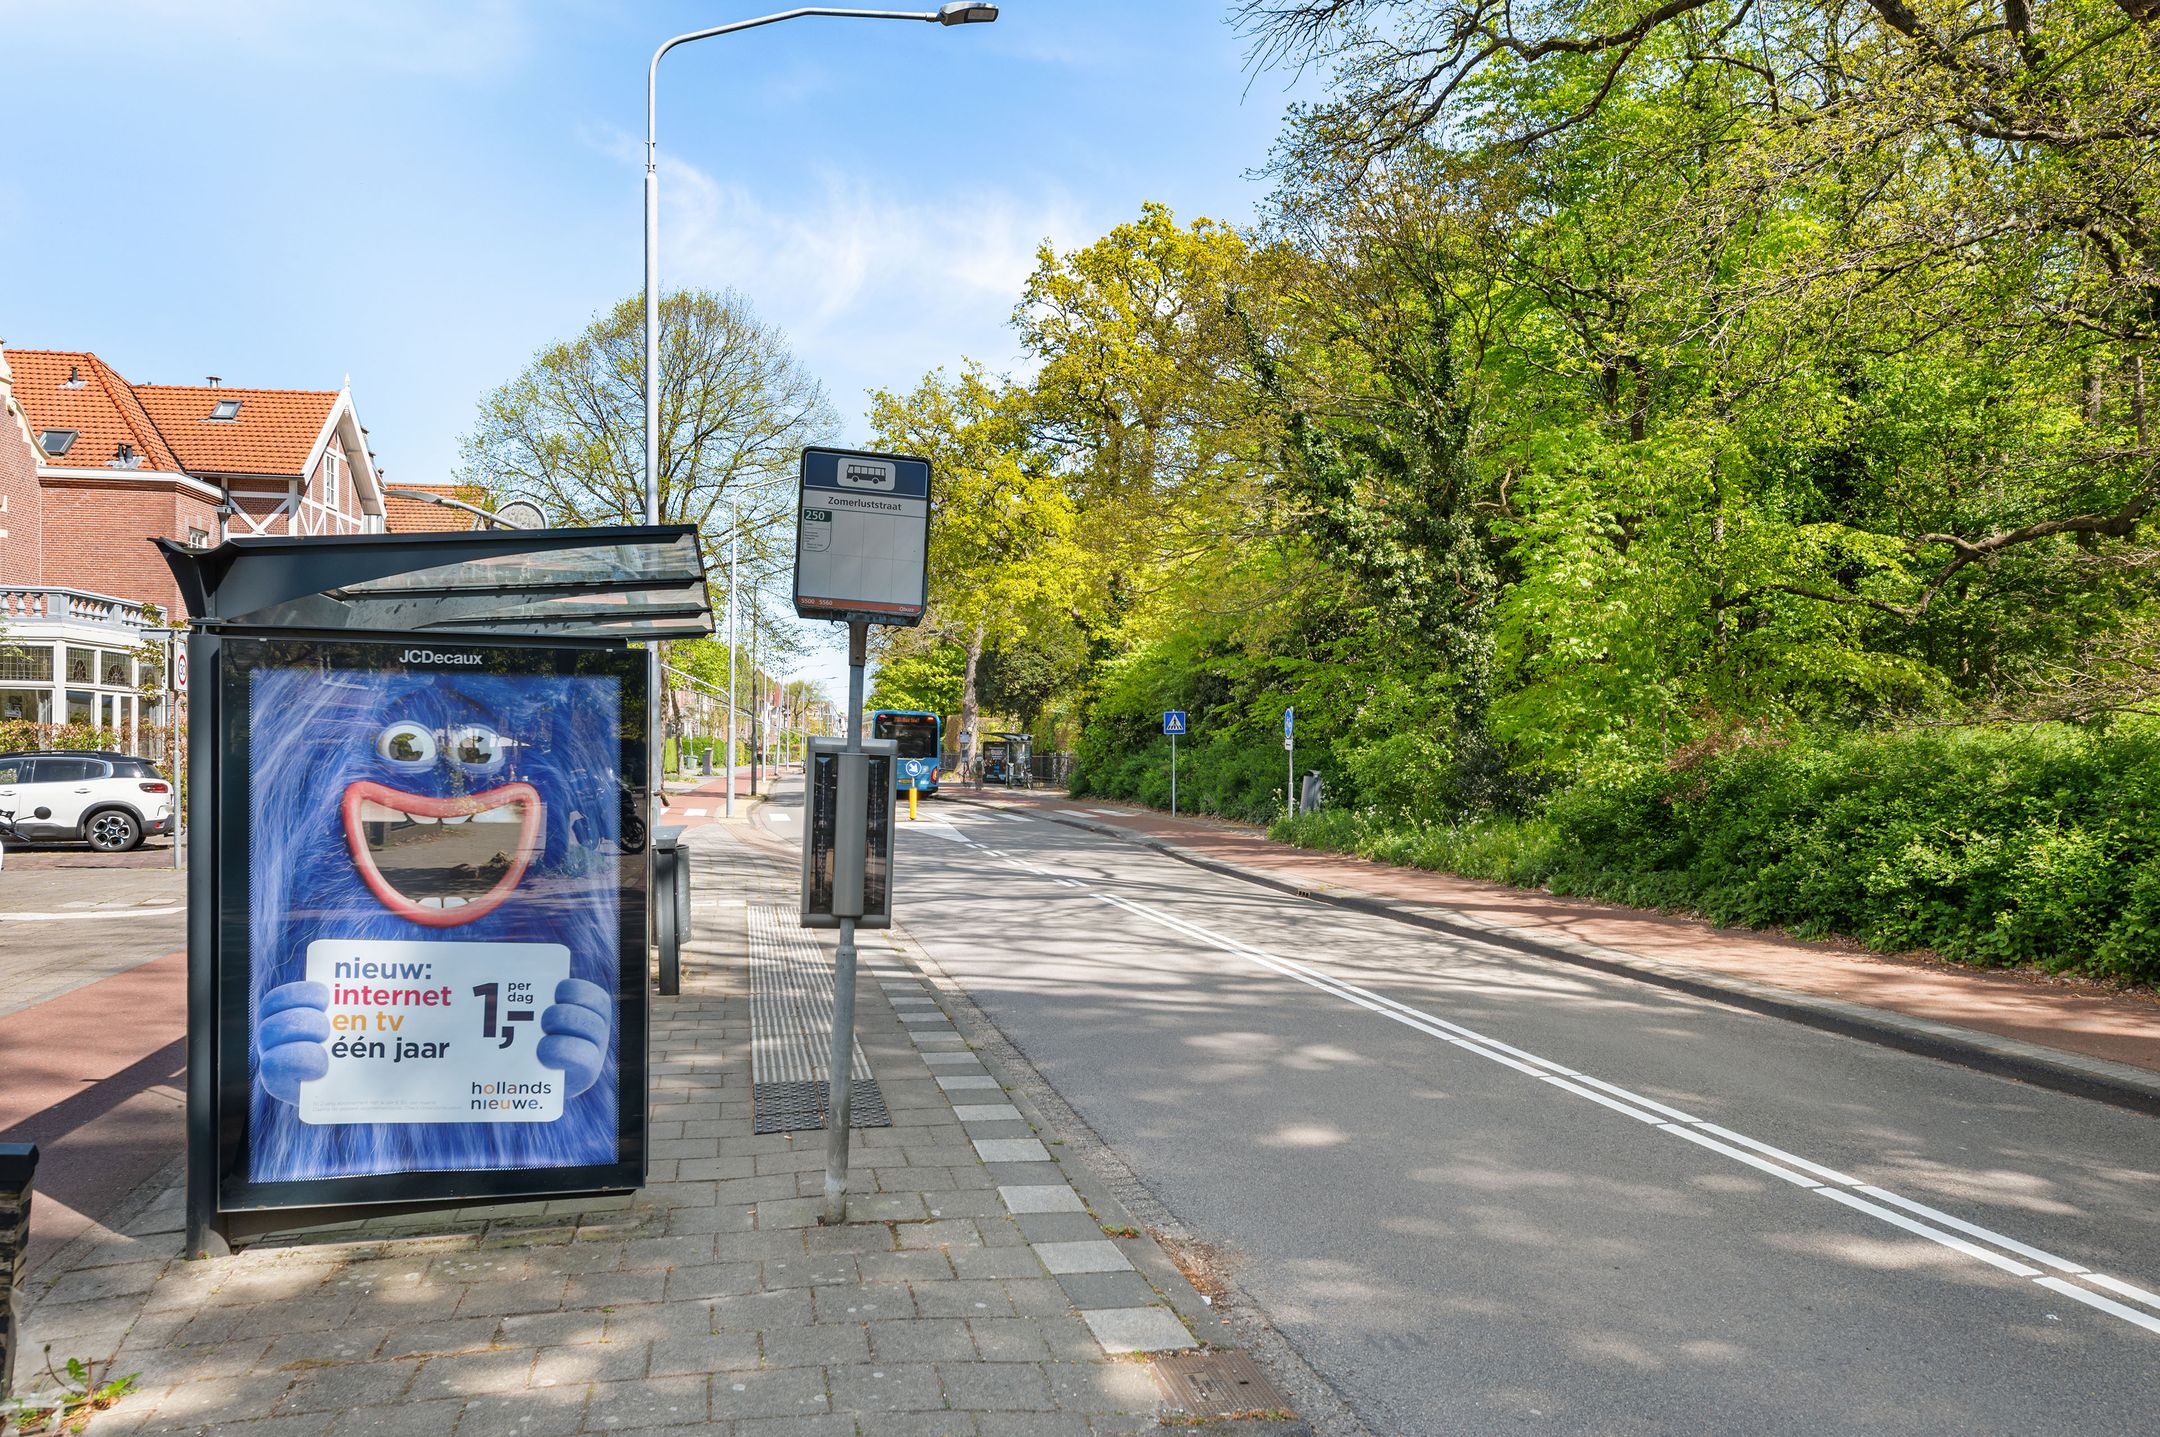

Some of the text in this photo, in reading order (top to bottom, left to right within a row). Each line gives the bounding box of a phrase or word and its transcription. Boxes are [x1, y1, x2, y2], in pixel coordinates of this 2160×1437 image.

[827, 496, 902, 511] Zomerluststraat
[805, 510, 825, 520] 250
[399, 649, 483, 665] JCDecaux
[335, 957, 432, 980] nieuw:
[507, 981, 531, 992] per
[333, 984, 452, 1007] internet
[507, 991, 534, 1004] dag
[332, 1012, 405, 1032] en tv
[331, 1036, 450, 1063] één jaar
[471, 1081, 552, 1095] hollands
[471, 1097, 544, 1111] nieuwe.
